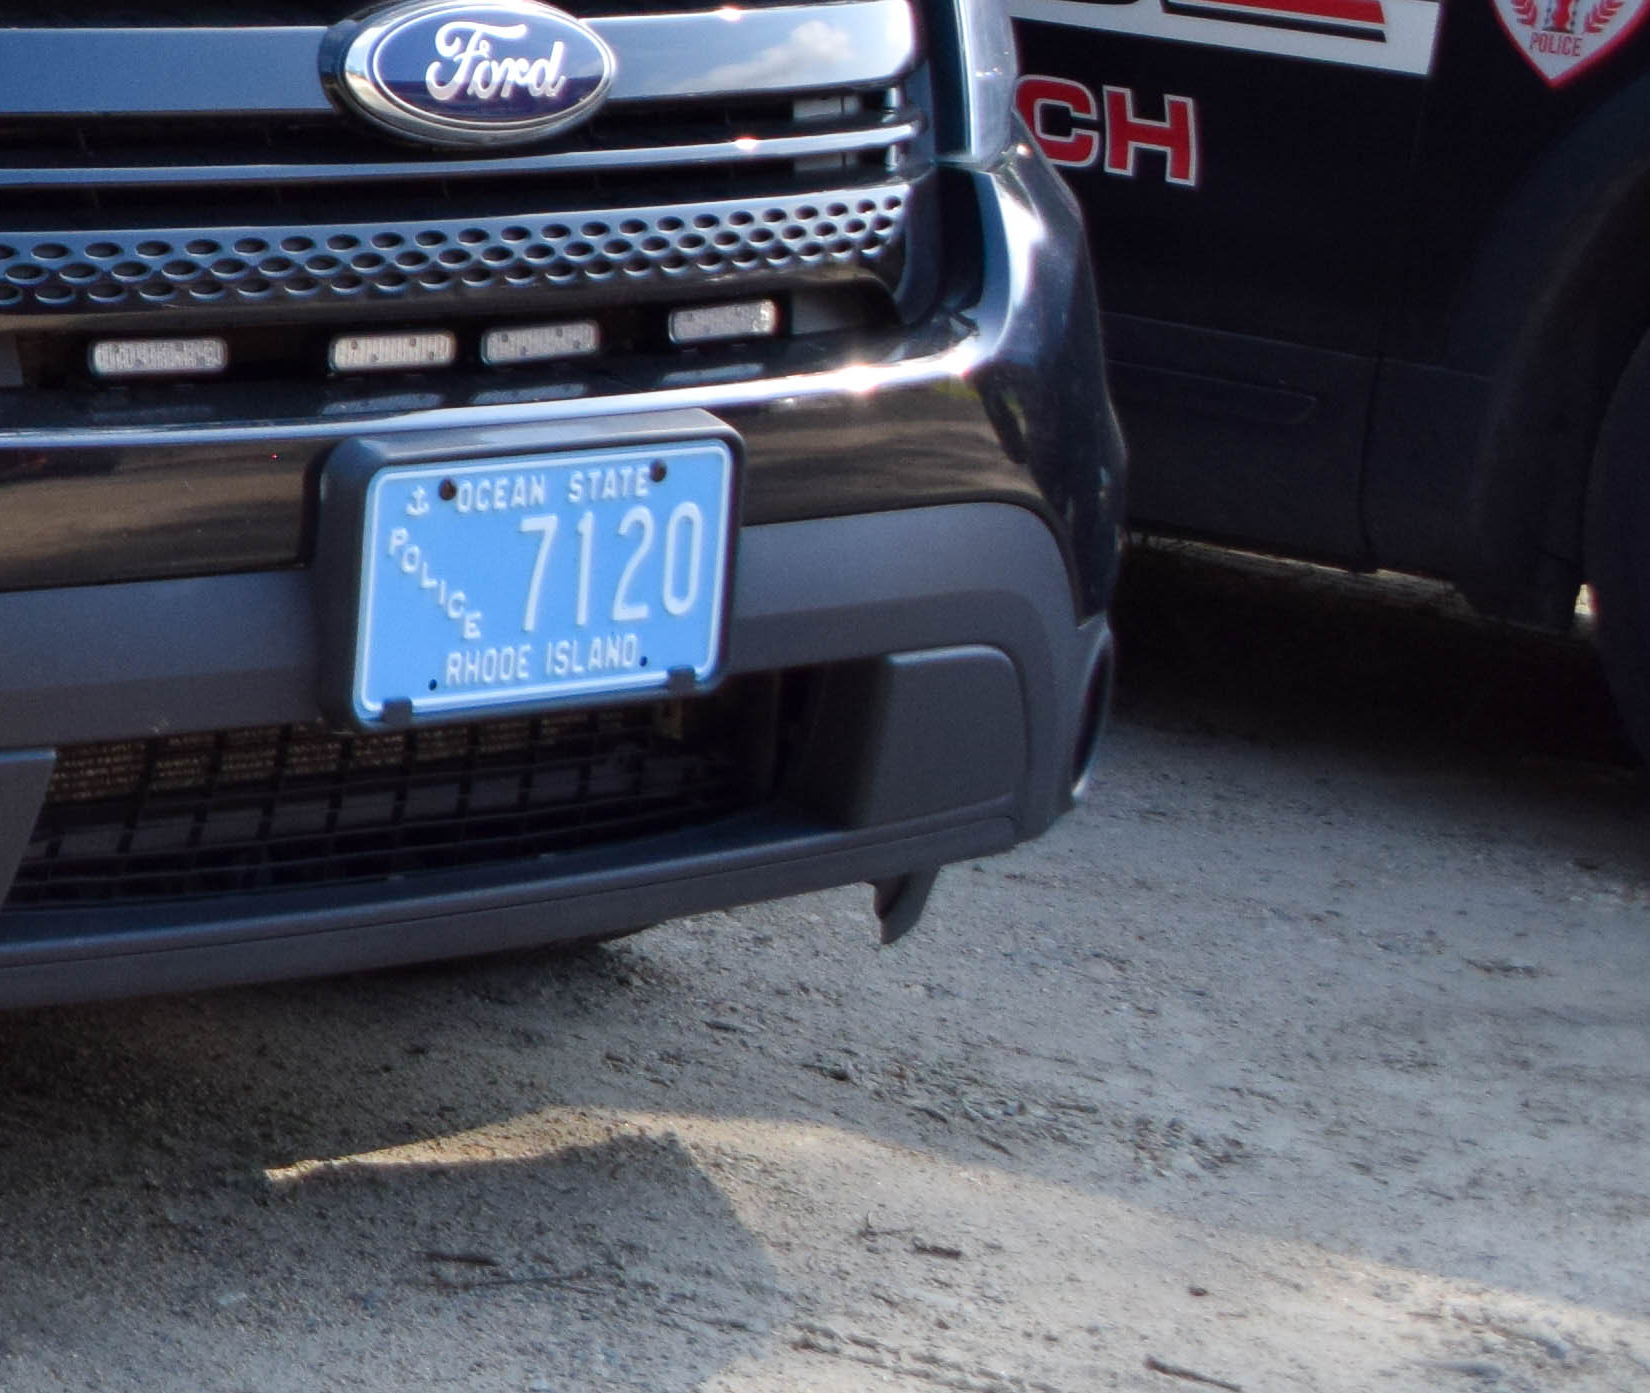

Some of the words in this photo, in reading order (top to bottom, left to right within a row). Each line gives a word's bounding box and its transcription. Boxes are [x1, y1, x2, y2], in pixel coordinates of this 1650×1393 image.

[425, 20, 567, 101] Ford
[1529, 31, 1584, 58] POLICE
[456, 475, 547, 514] OCEAN
[568, 466, 651, 502] STATE
[387, 527, 484, 640] POLICE
[519, 501, 703, 632] 7120
[445, 643, 533, 687] RHODE
[546, 633, 638, 676] ISLAND
